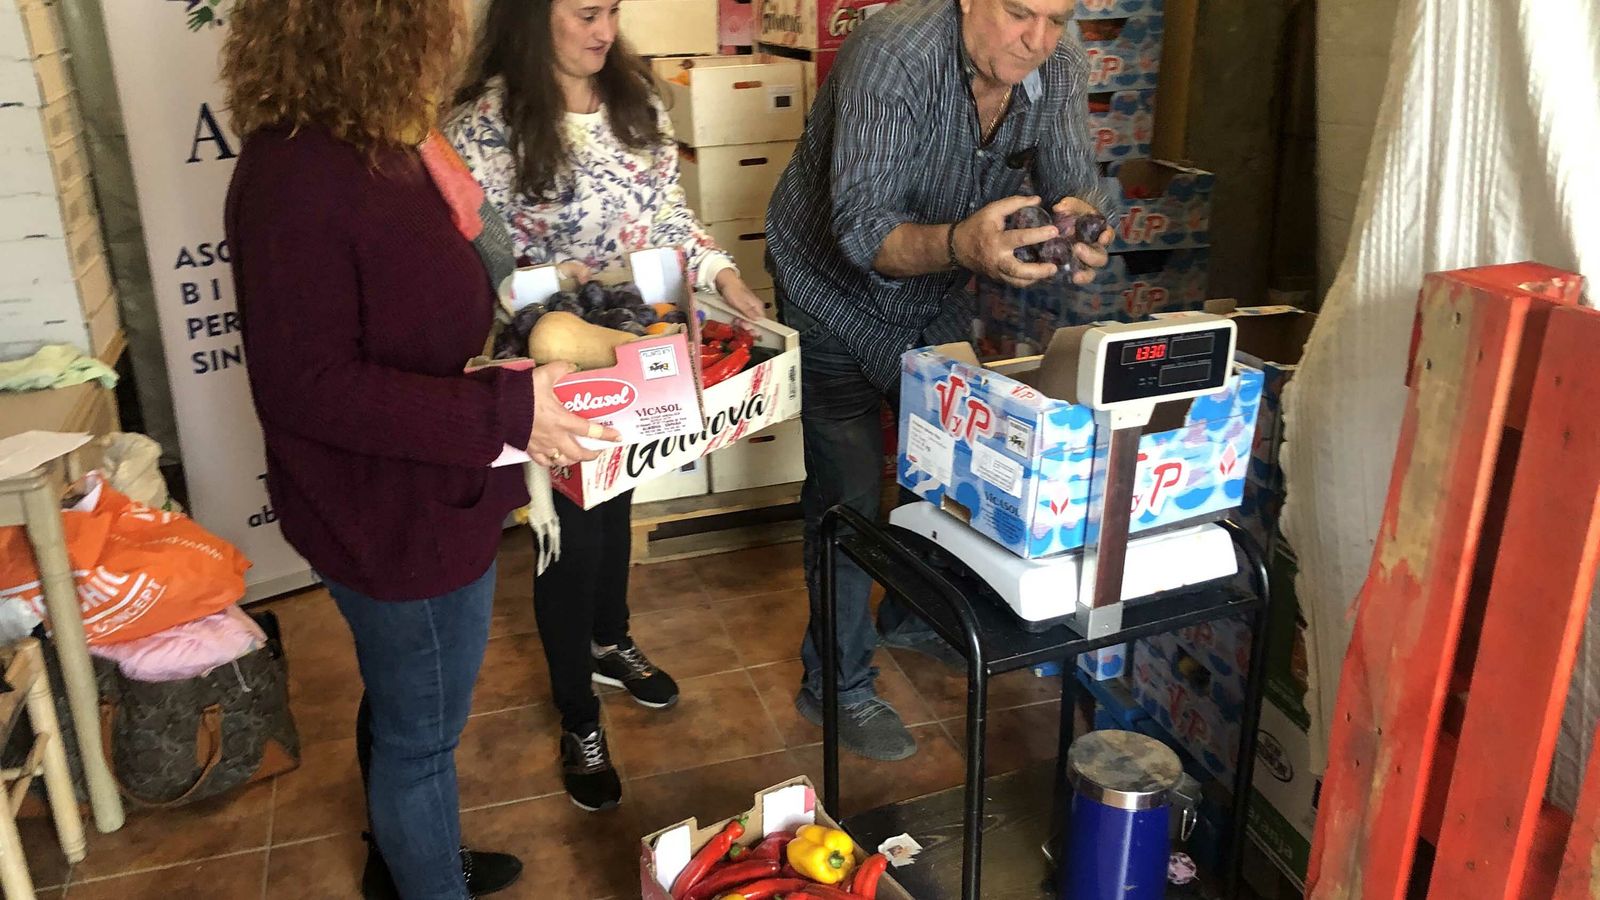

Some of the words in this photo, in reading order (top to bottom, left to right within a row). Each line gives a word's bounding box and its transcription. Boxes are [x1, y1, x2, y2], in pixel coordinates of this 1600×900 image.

[186, 103, 238, 163] A
[186, 311, 241, 340] PER
[192, 345, 242, 374] SIN
[562, 385, 631, 413] eblasol
[634, 403, 684, 418] VICASOL
[935, 374, 992, 446] VyP
